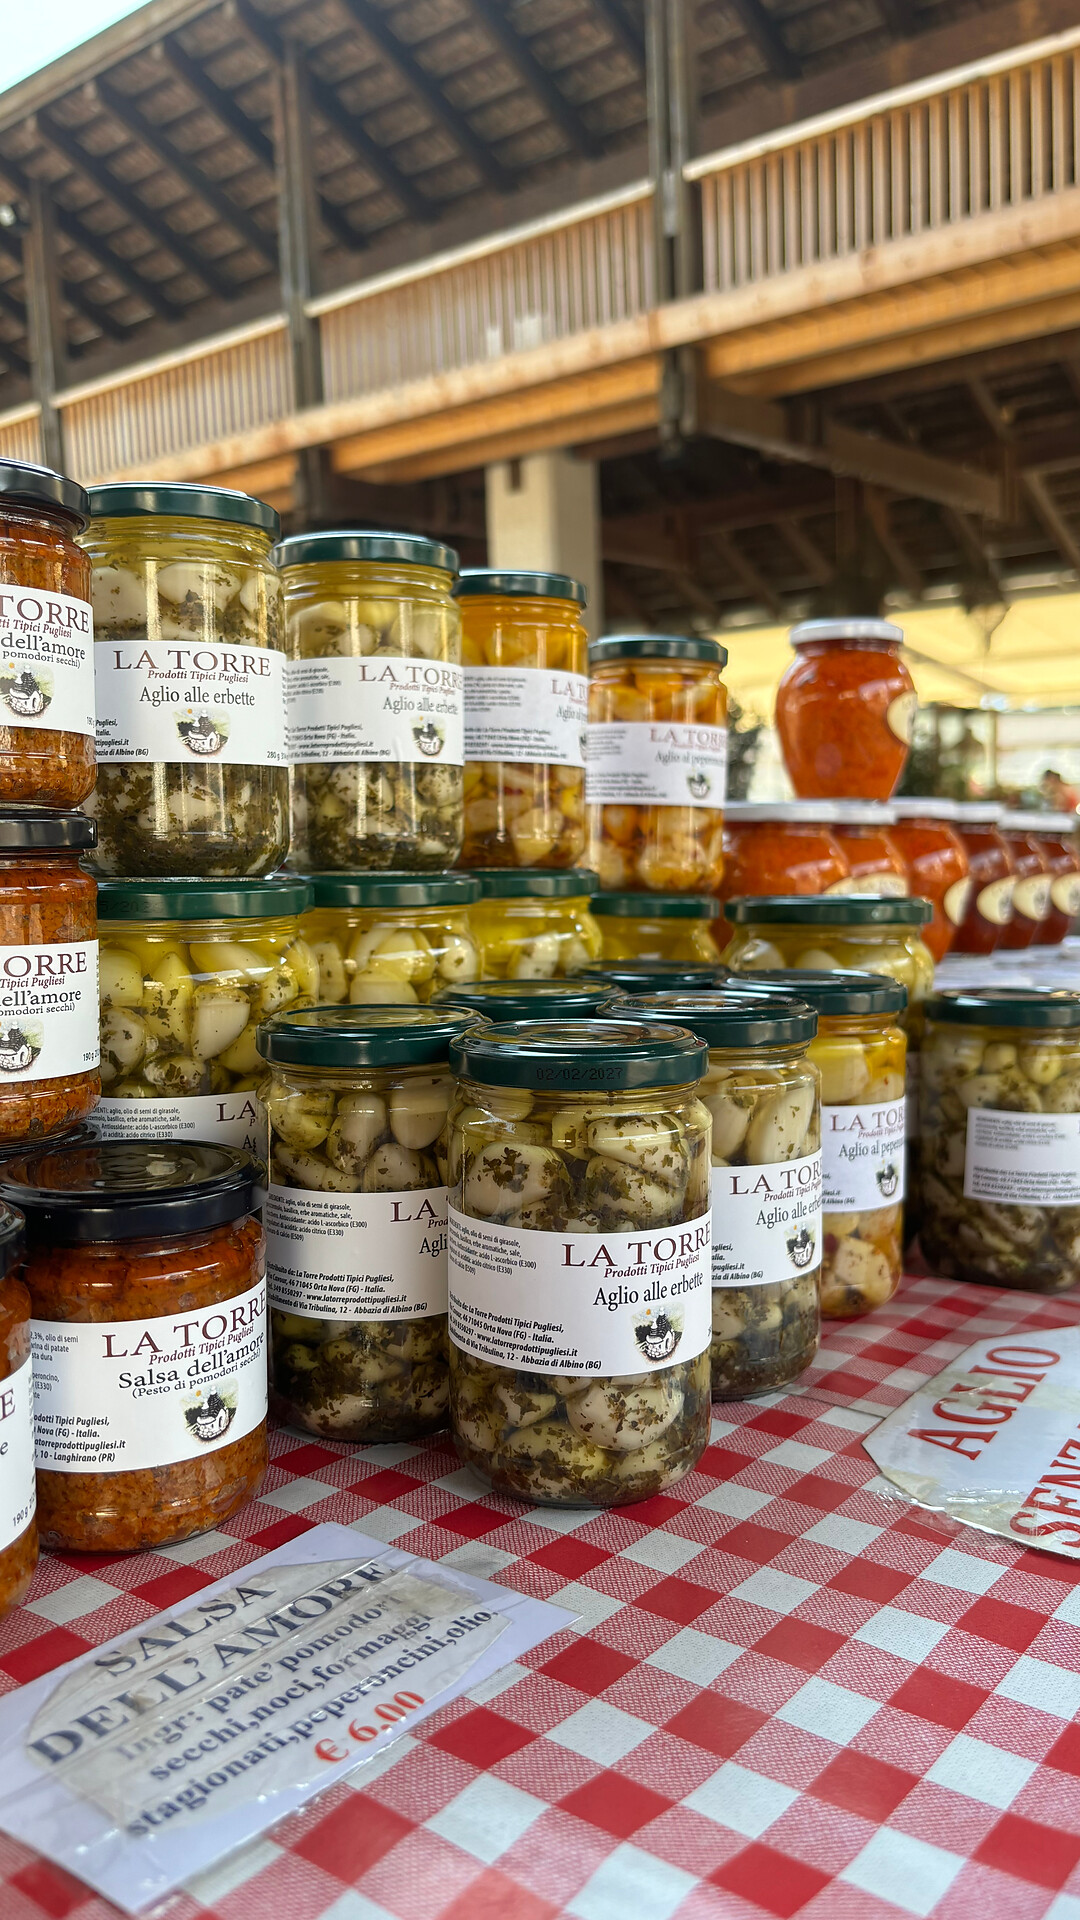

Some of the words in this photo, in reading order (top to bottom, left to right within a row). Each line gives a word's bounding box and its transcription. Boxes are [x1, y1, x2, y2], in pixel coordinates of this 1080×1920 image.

[13, 619, 40, 633] Tipici
[43, 622, 72, 638] Pugliesi
[0, 632, 85, 660] dell'amore
[3, 650, 54, 662] pomodori
[56, 656, 81, 669] secchi)
[113, 650, 159, 670] LA
[167, 650, 271, 677] TORRE
[148, 669, 187, 680] Prodotti
[190, 671, 216, 682] Tipici
[218, 672, 249, 684] Pugliesi
[359, 664, 398, 682] LA
[139, 685, 180, 707] Aglio
[184, 686, 209, 703] alle
[213, 688, 255, 706] erbette
[551, 679, 574, 697] LA
[383, 696, 415, 714] Aglio
[417, 697, 434, 712] alle
[650, 727, 677, 743] LA
[115, 748, 134, 756] Albino
[655, 751, 680, 766] Aglio
[0, 976, 29, 991] Tipici
[31, 975, 65, 990] Pugliesi
[0, 989, 81, 1007] ell'amore
[46, 1002, 76, 1014] secchi)
[536, 1067, 623, 1081] 02/02/2027
[158, 1107, 180, 1115] girasole,
[216, 1099, 256, 1122] LA
[178, 1122, 195, 1130] (E300)
[829, 1113, 865, 1132] LA
[838, 1141, 869, 1162] Aglio
[870, 1140, 879, 1155] al
[729, 1173, 773, 1195] LA
[763, 1188, 795, 1202] Prodotti
[310, 1210, 340, 1219] aromatiche,
[329, 1203, 352, 1211] girasole,
[390, 1199, 439, 1222] LA
[756, 1206, 789, 1229] Aglio
[791, 1201, 807, 1220] alle
[320, 1219, 349, 1228] L-ascorbico
[327, 1229, 344, 1237] (E330)
[419, 1233, 448, 1257] Agli
[499, 1237, 520, 1248] girasole,
[561, 1243, 618, 1267] LA
[627, 1221, 711, 1265] TORRE
[490, 1254, 517, 1266] L-ascorbico
[518, 1259, 537, 1269] (E300)
[509, 1249, 522, 1258] sale,
[496, 1265, 512, 1275] (E330)
[604, 1265, 648, 1278] Prodotti
[650, 1260, 674, 1275] Tipici
[675, 1252, 700, 1270] Pugliesi
[303, 1271, 318, 1280] Torre
[318, 1273, 345, 1282] Prodotti
[346, 1274, 364, 1283] Tipici
[365, 1274, 394, 1284] Pugliesi,
[729, 1271, 750, 1280] Albino
[295, 1281, 313, 1289] 71045
[313, 1283, 328, 1291] Orta
[328, 1284, 345, 1292] Nova
[346, 1285, 360, 1293] (FG)
[364, 1285, 386, 1293] Italia.
[593, 1285, 639, 1312] Aglio
[643, 1280, 668, 1302] alle
[670, 1271, 704, 1296] erbette
[299, 1302, 308, 1310] Via
[308, 1303, 338, 1314] Tribulina,
[340, 1306, 348, 1314] 12
[354, 1306, 382, 1314] Abbazia
[382, 1306, 390, 1314] di
[390, 1305, 412, 1313] Albino
[413, 1302, 427, 1312] (BG)
[306, 1294, 407, 1305] www.latorreprodottipugliesi.it
[101, 1331, 163, 1358] LA
[173, 1289, 266, 1348] TORRE
[474, 1307, 488, 1318] Torre
[488, 1312, 513, 1325] Prodotti
[514, 1318, 532, 1329] Tipici
[532, 1321, 564, 1333] Pugliesi,
[45, 1334, 56, 1342] olio
[63, 1335, 79, 1343] semi
[468, 1316, 483, 1328] 71045
[483, 1322, 496, 1333] Orta
[496, 1326, 513, 1337] Nova
[513, 1329, 527, 1340] (FG)
[532, 1332, 554, 1343] Italia.
[50, 1345, 69, 1353] patate
[149, 1346, 196, 1365] Prodotti
[198, 1339, 225, 1355] Tipici
[226, 1323, 254, 1346] Pugliesi
[477, 1332, 578, 1357] www.latorreprodottipugliesi.it
[40, 1353, 53, 1361] dura
[118, 1369, 180, 1388] Salsa
[187, 1332, 264, 1377] dell'amore
[478, 1343, 505, 1359] Tribulina,
[507, 1352, 515, 1361] 12
[521, 1354, 549, 1366] Abbazia
[550, 1358, 558, 1367] di
[559, 1359, 584, 1369] Albino
[585, 1360, 602, 1370] (BG)
[132, 1385, 170, 1399] (Pesto
[174, 1380, 186, 1389] di
[189, 1363, 239, 1390] pomodori
[239, 1347, 261, 1369] secchi)
[907, 1346, 1061, 1461] AGLIO
[55, 1415, 75, 1426] Tipici
[75, 1416, 110, 1427] Pugliesi,
[37, 1425, 54, 1435] Nova
[55, 1427, 70, 1438] (FG)
[75, 1429, 100, 1438] Italia.
[40, 1449, 49, 1459] 10
[53, 1451, 97, 1463] Langhirano
[98, 1452, 116, 1463] (PR)
[95, 1586, 277, 1677] SALSA
[314, 1738, 349, 1763] €
